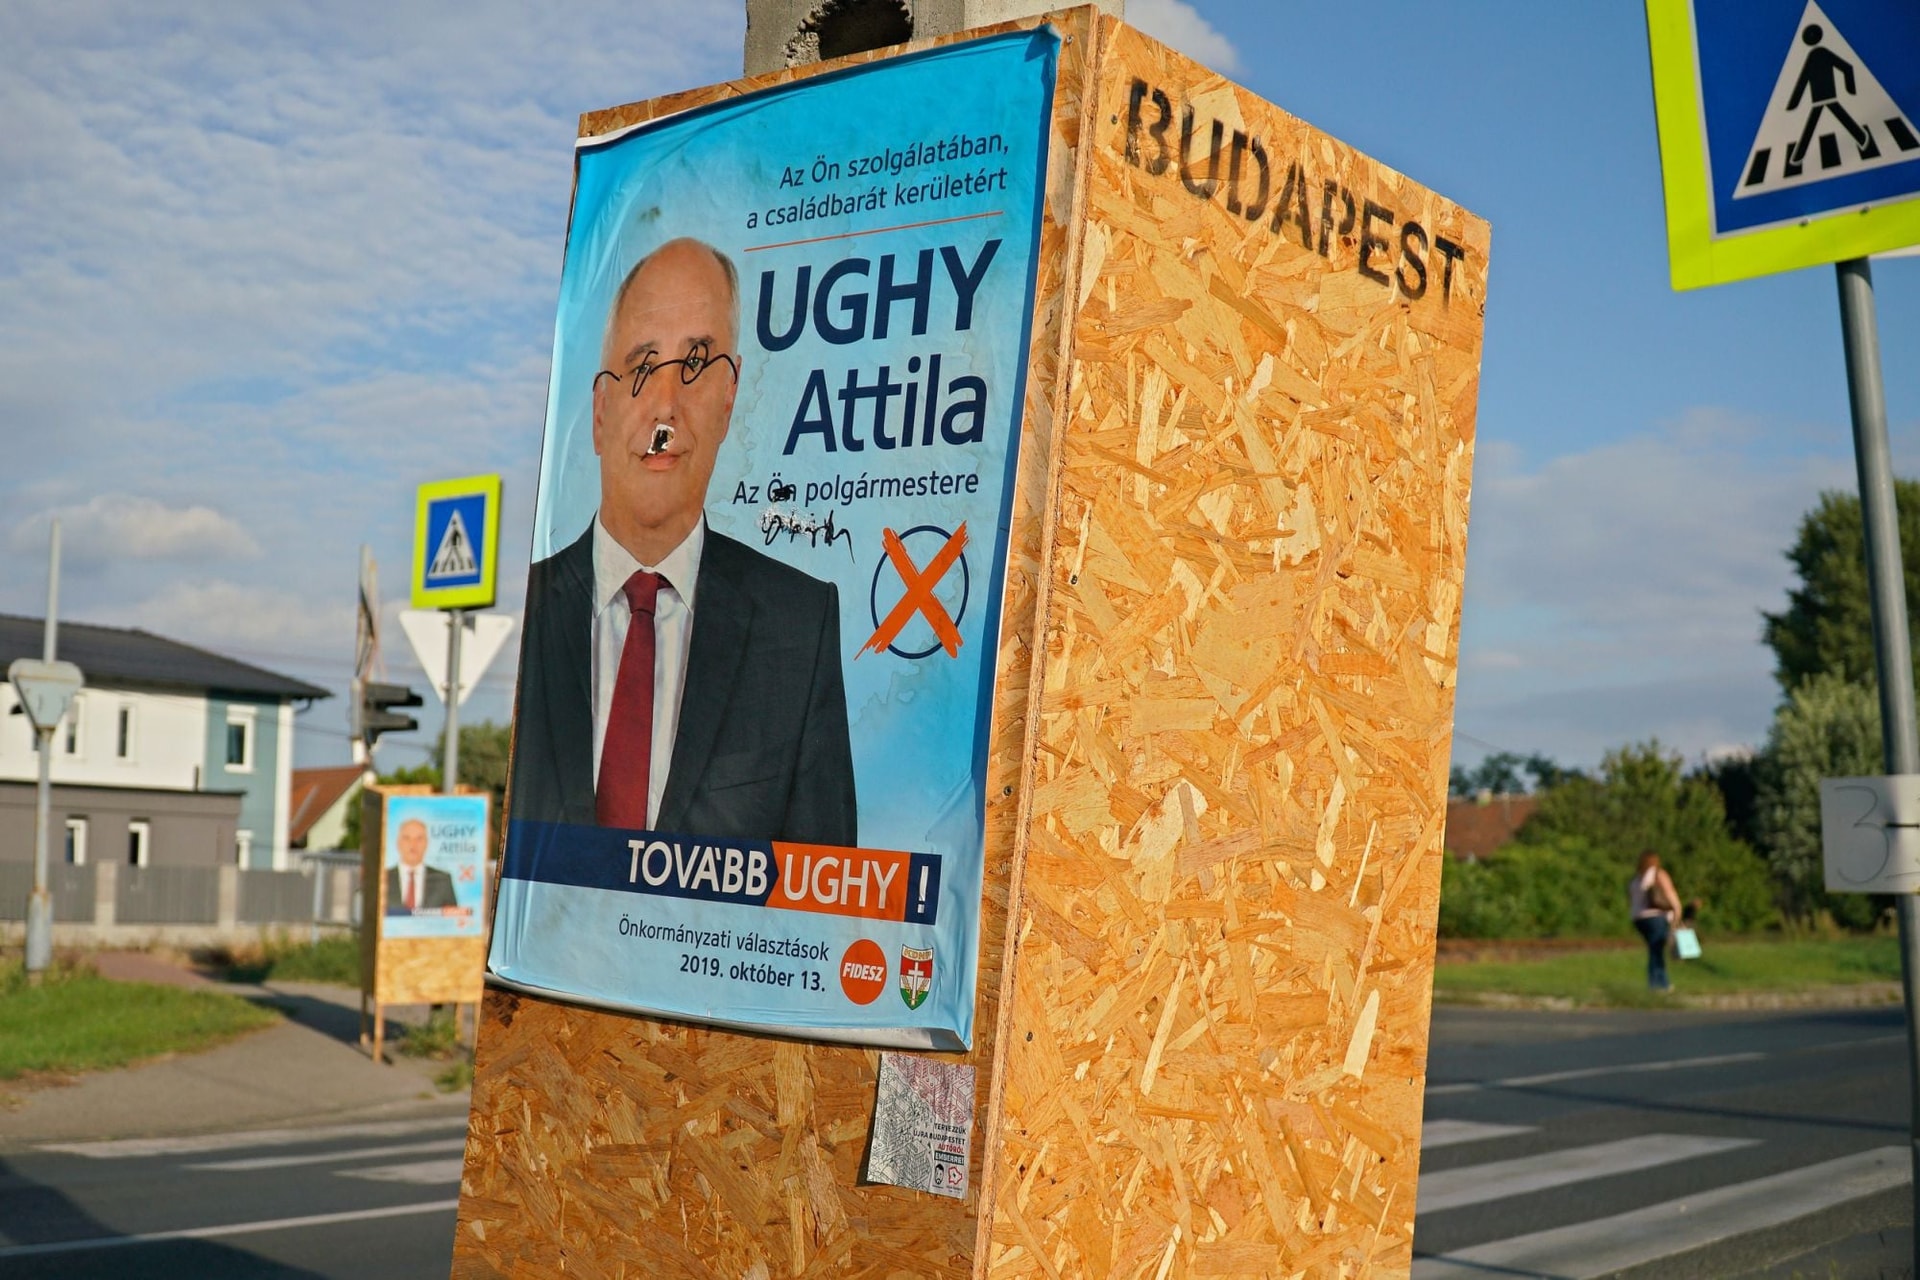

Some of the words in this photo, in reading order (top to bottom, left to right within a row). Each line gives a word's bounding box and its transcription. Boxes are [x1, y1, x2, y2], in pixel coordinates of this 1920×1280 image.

[780, 166, 804, 189] Az
[811, 155, 840, 184] Ön
[848, 133, 1009, 176] szolgálatában,
[746, 211, 758, 229] a
[765, 187, 887, 226] családbarát
[895, 167, 1007, 206] kerületért
[1124, 75, 1464, 306] BUDAPEST
[756, 238, 1003, 352] UGHY
[782, 353, 988, 456] Attila
[733, 481, 759, 505] Az
[805, 470, 979, 507] polgármestere
[430, 825, 476, 838] UGHY
[782, 853, 900, 910] UGHY
[619, 913, 731, 949] Önkormányzati
[736, 927, 830, 962] választások
[679, 953, 724, 979] 2019.
[729, 961, 795, 989] október
[800, 970, 826, 993] 13.
[841, 961, 885, 983] FIDESZ
